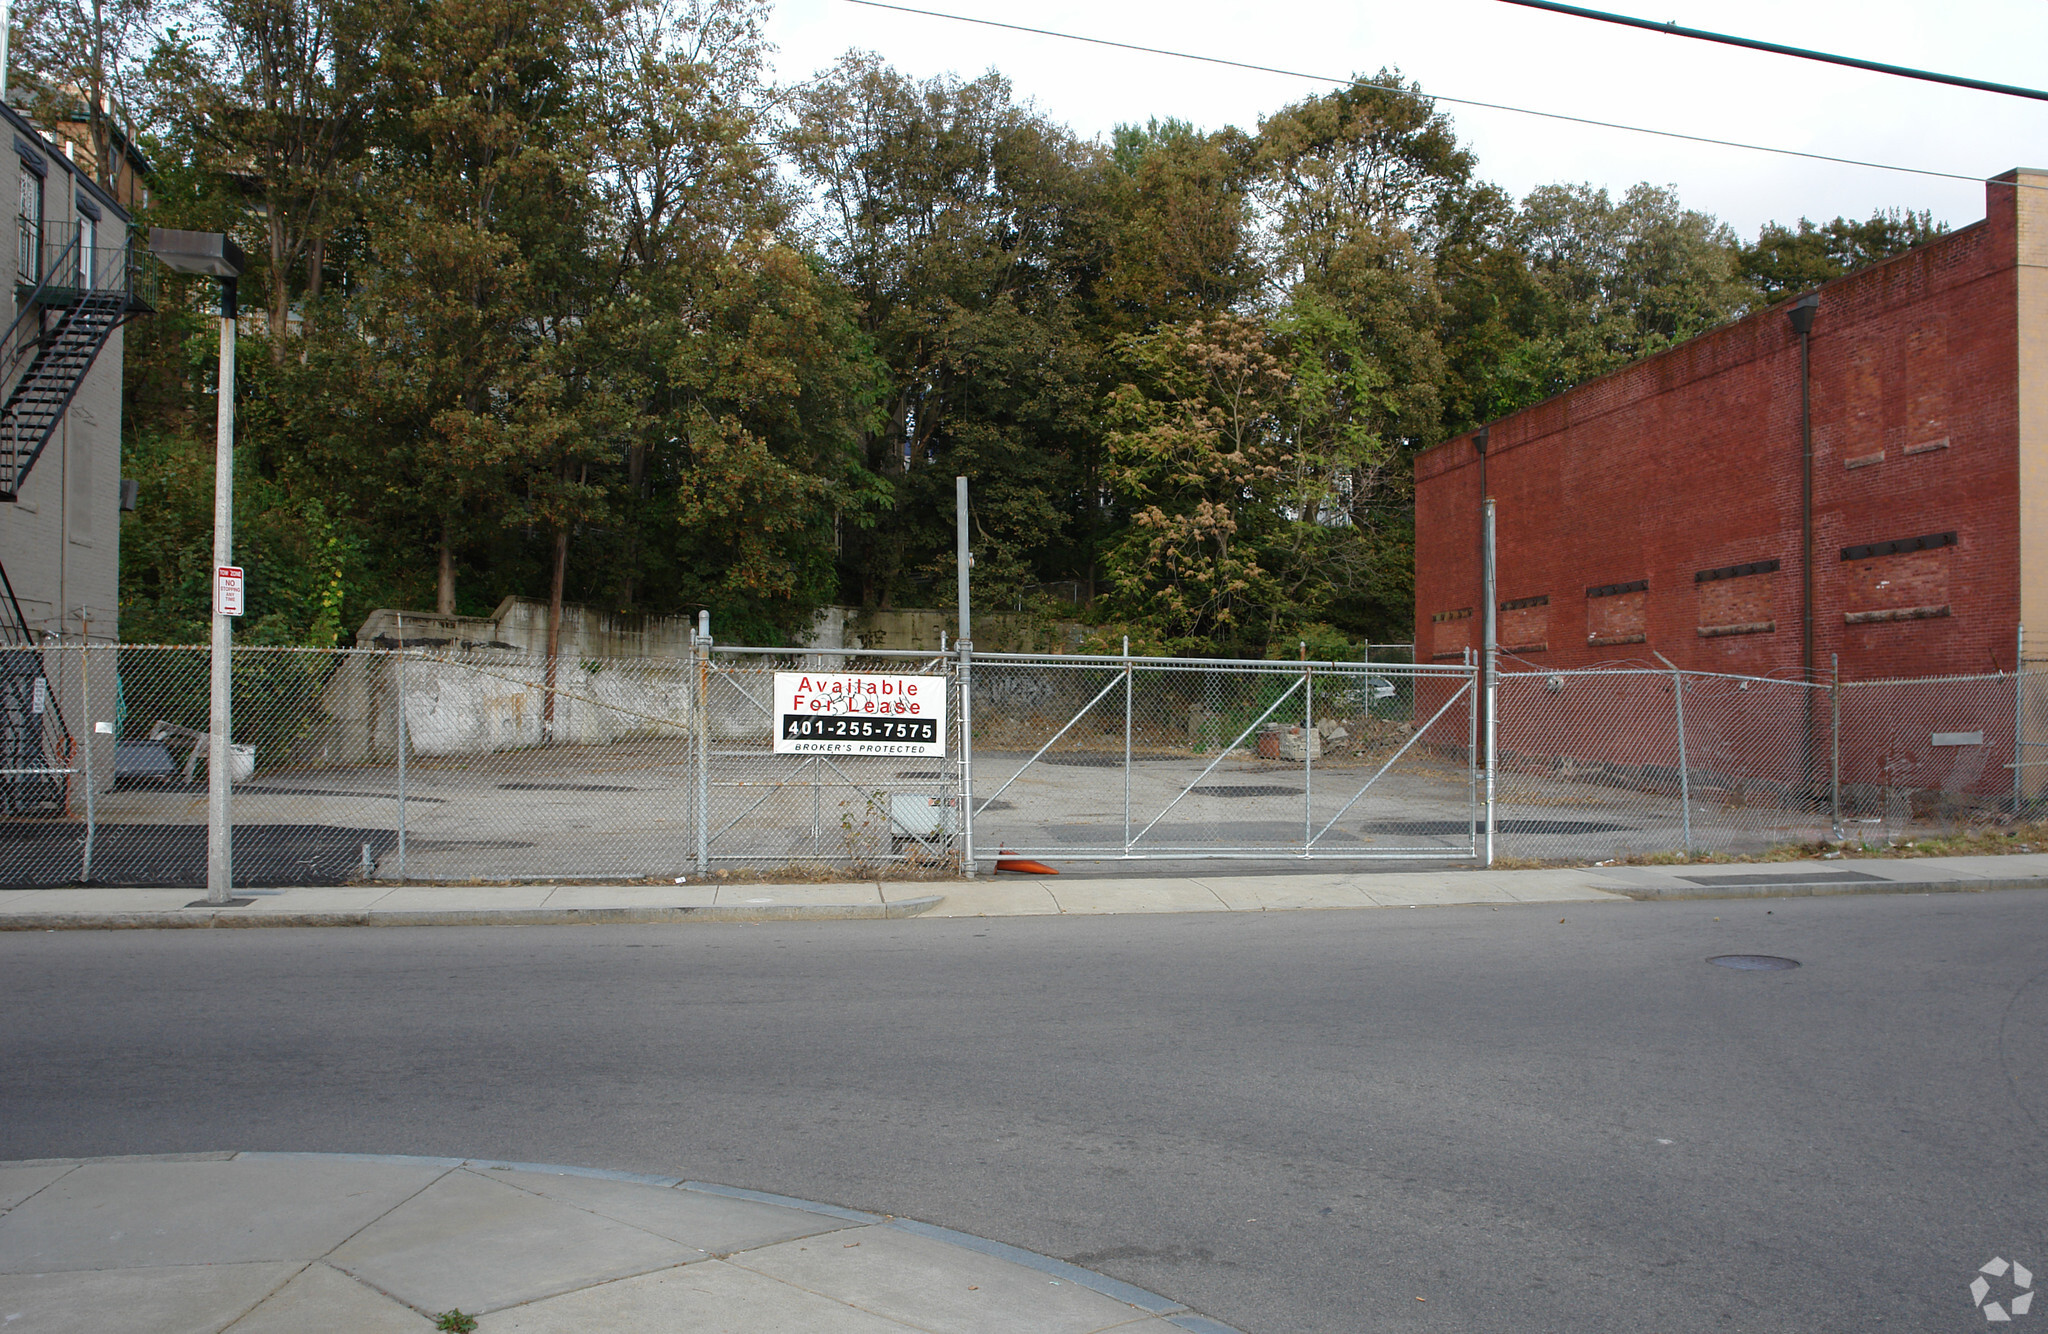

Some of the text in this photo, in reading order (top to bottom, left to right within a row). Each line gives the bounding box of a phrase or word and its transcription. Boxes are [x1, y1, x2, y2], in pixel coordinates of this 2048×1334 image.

[797, 676, 918, 696] Available
[793, 695, 921, 715] For Lease
[788, 720, 932, 739] 401-255-7575
[794, 743, 926, 754] BROKER'S PROTECTED
